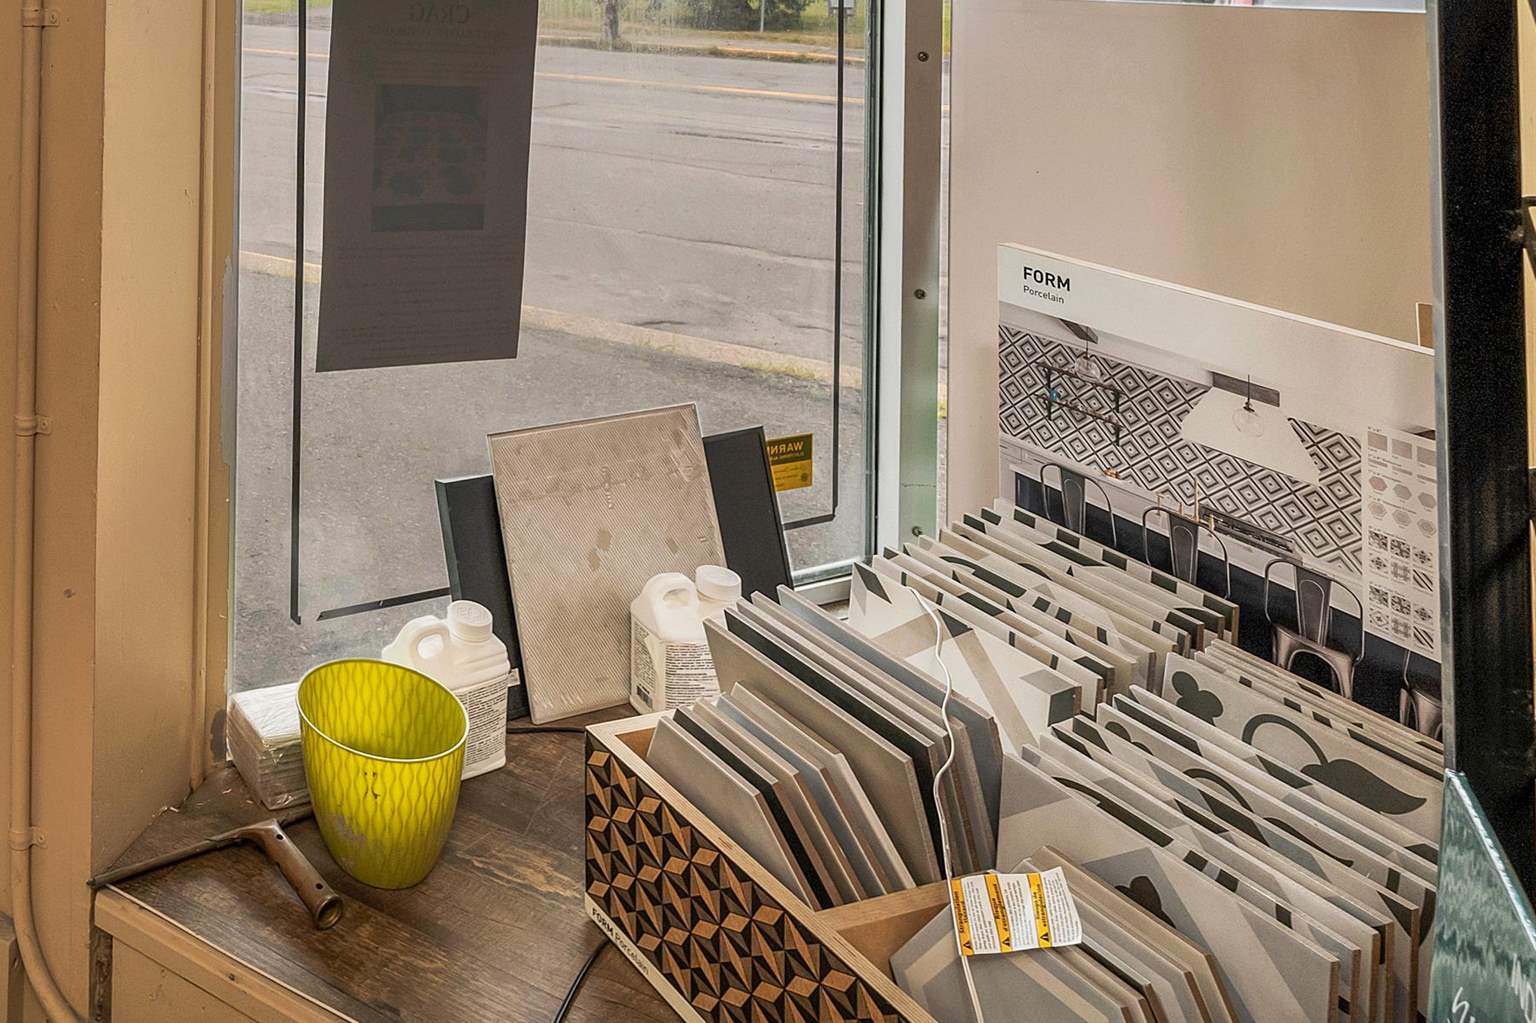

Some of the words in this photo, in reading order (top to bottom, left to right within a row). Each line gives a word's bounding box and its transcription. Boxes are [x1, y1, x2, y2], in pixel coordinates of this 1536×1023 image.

[1024, 266, 1070, 292] FORM
[1024, 285, 1064, 304] Porcelain
[592, 908, 614, 936] FORM
